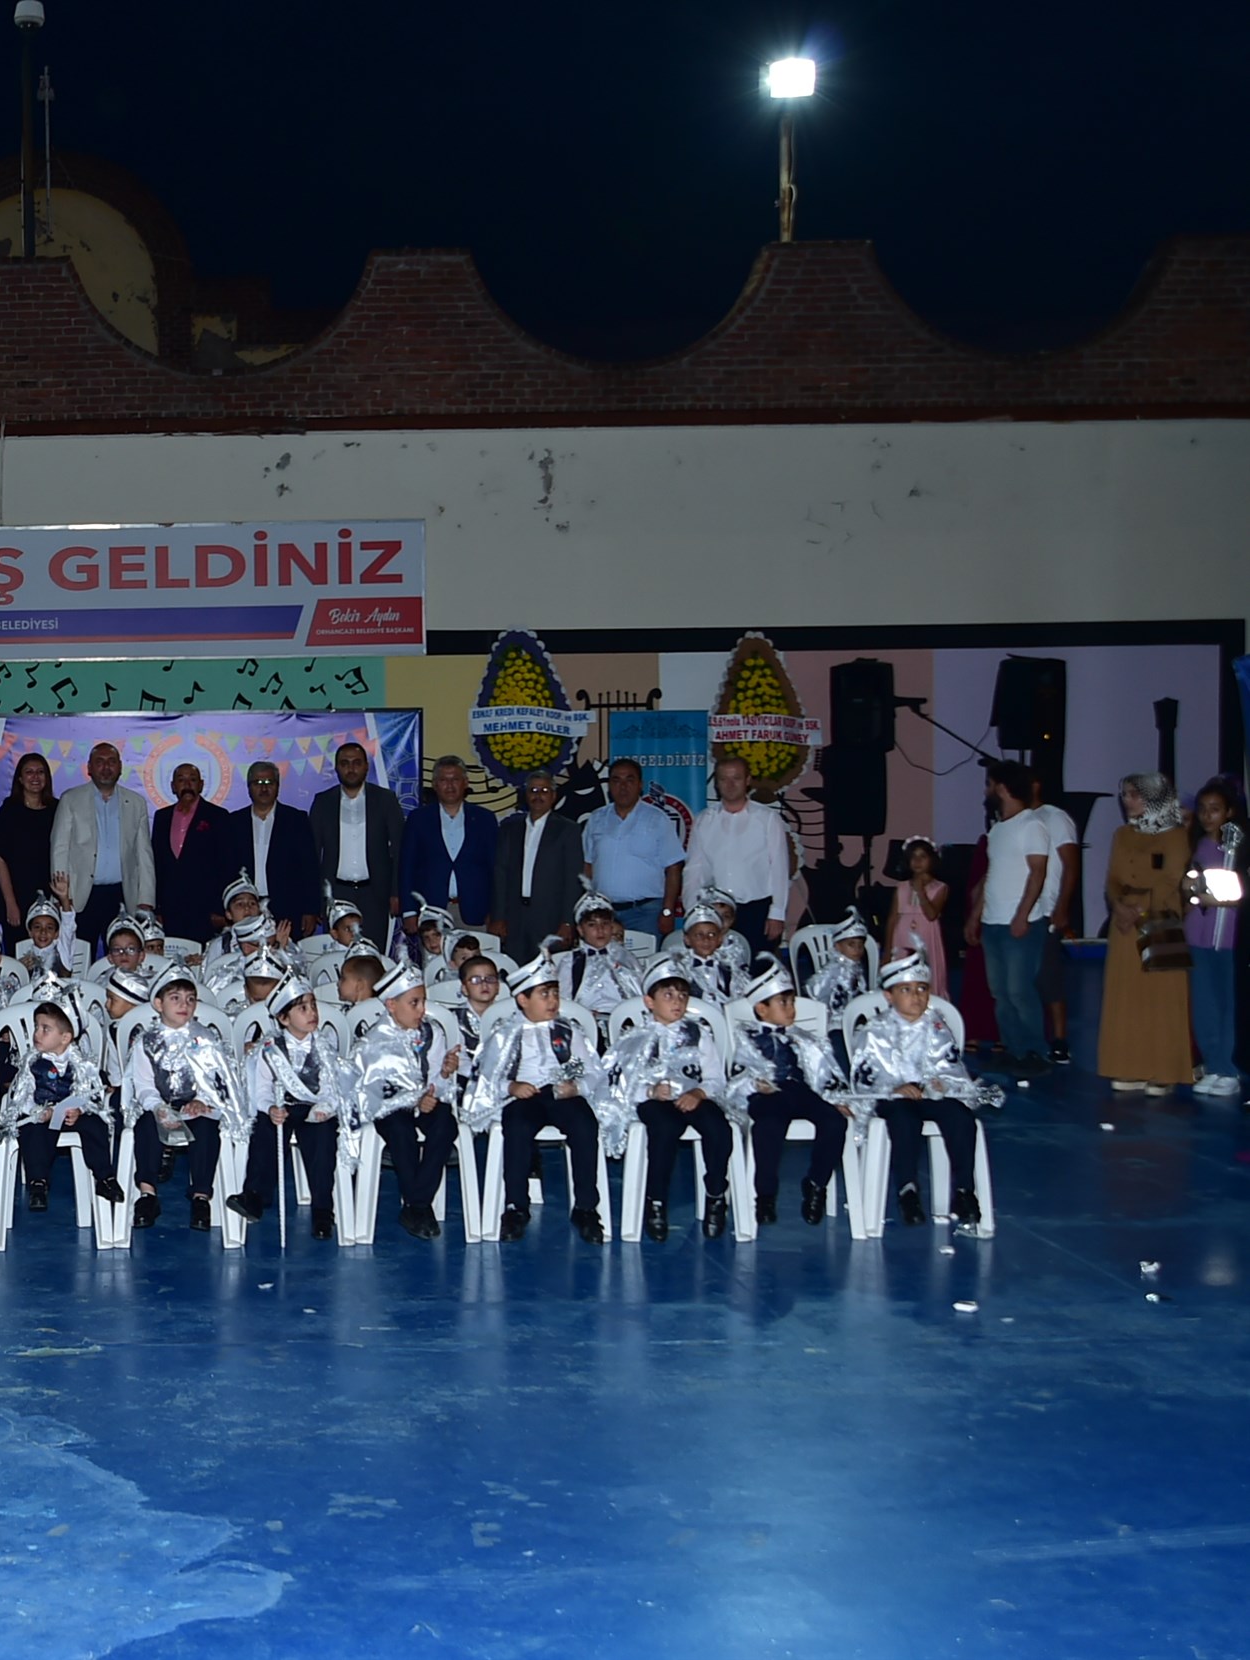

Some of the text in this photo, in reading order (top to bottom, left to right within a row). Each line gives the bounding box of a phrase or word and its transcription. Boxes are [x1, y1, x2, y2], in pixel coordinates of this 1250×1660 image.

[47, 529, 404, 592] GELDİNİZ
[328, 608, 361, 625] Bekir
[483, 721, 533, 733] MEHMET
[715, 729, 749, 741] AHMET
[751, 729, 783, 741] FARUK
